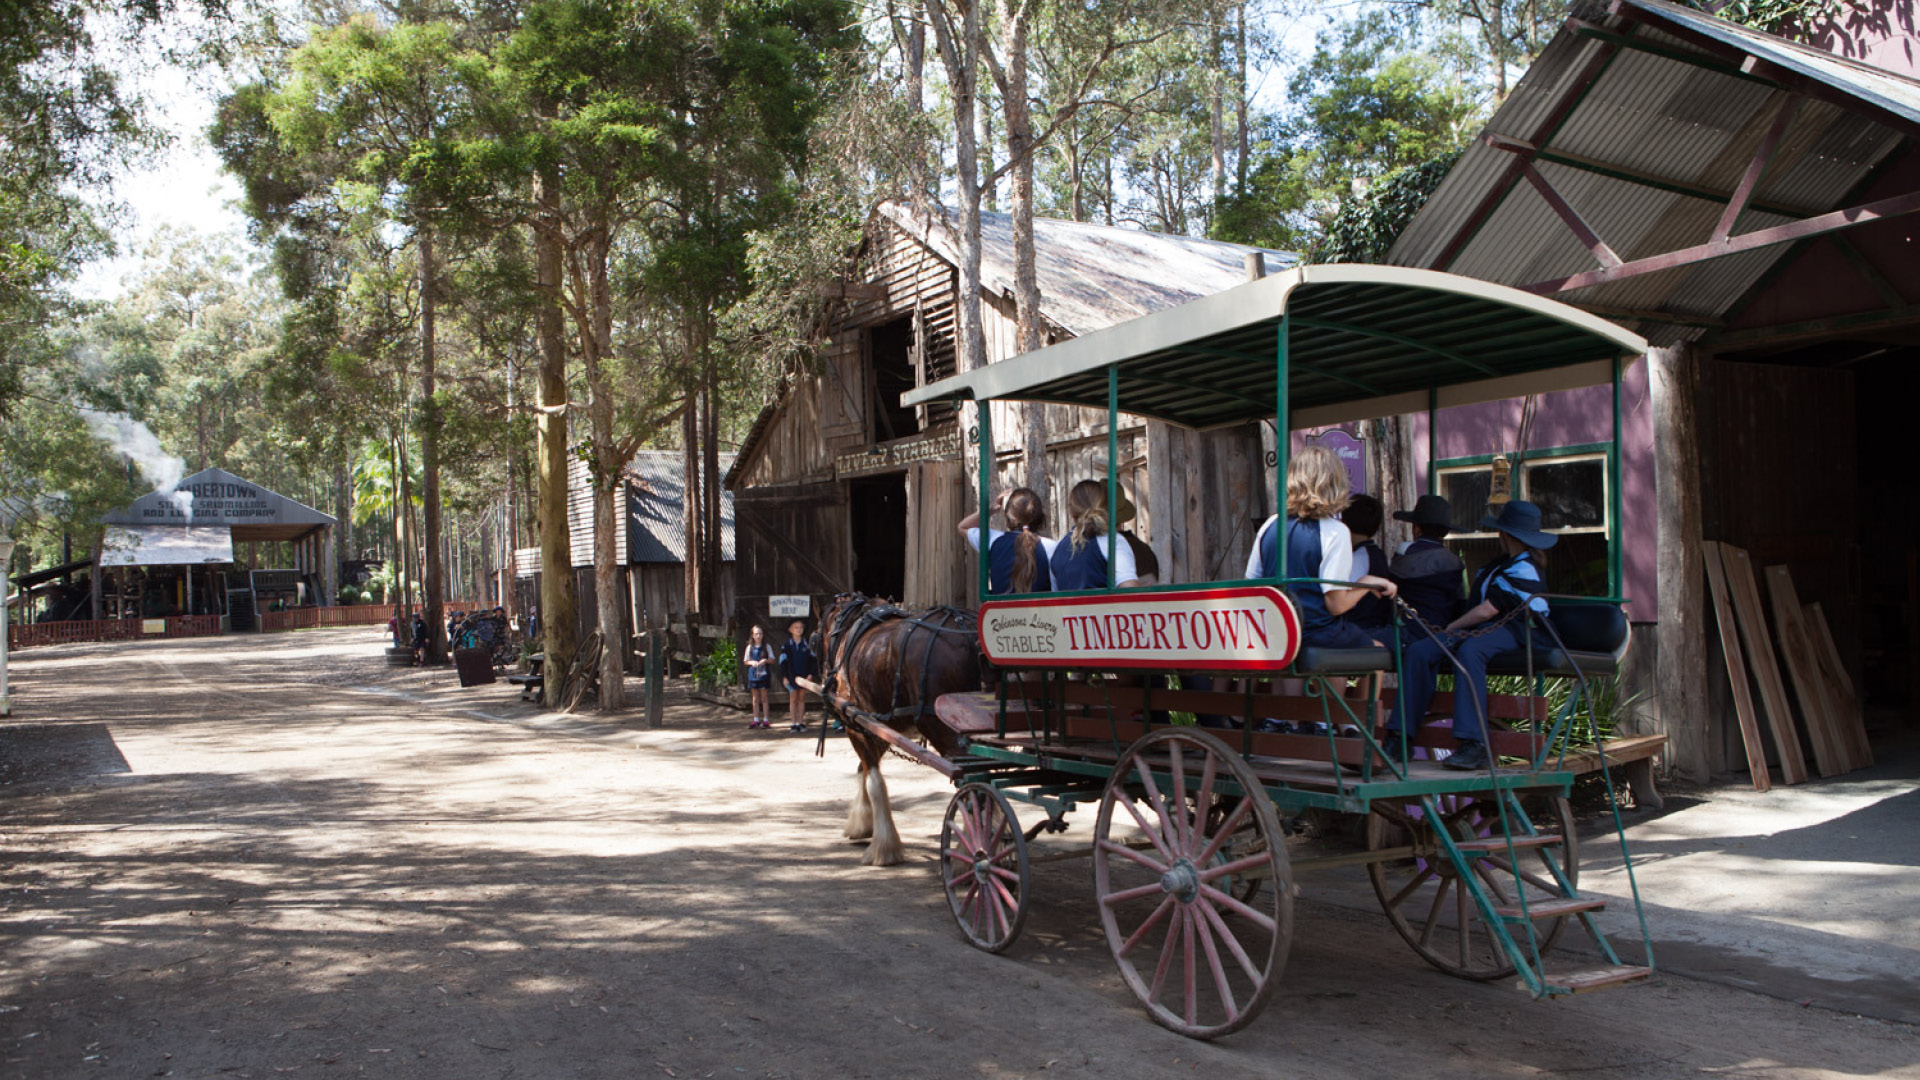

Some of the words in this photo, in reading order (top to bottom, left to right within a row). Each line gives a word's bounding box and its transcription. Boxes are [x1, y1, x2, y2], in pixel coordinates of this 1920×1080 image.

[893, 432, 956, 465] STABLES
[143, 509, 165, 518] AND
[225, 509, 276, 518] COMPANY
[1029, 613, 1058, 636] Livery
[1063, 608, 1269, 651] TIMBERTOWN
[996, 635, 1055, 653] STABLES
